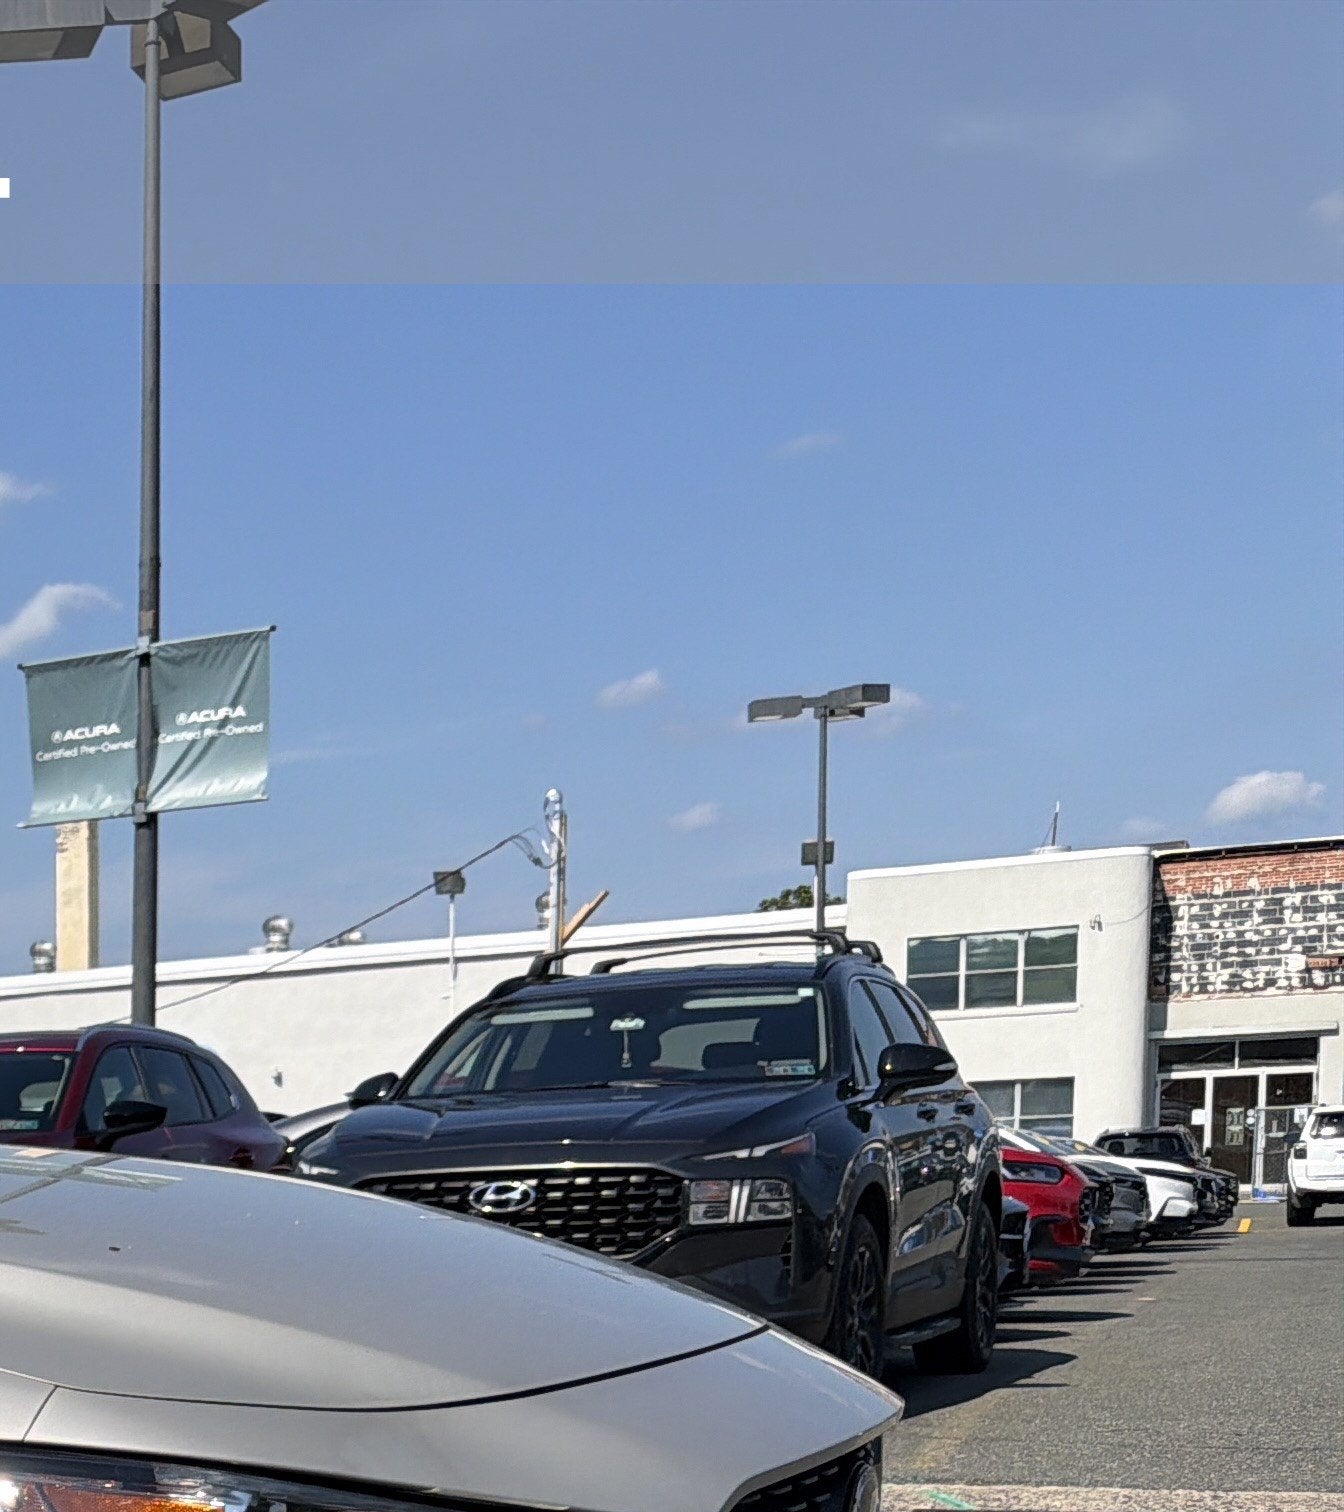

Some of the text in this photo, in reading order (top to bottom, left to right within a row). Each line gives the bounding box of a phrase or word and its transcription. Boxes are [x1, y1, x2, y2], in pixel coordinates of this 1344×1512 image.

[187, 705, 246, 724] ACURA
[63, 723, 121, 741] ACURA
[158, 730, 201, 744] Certified
